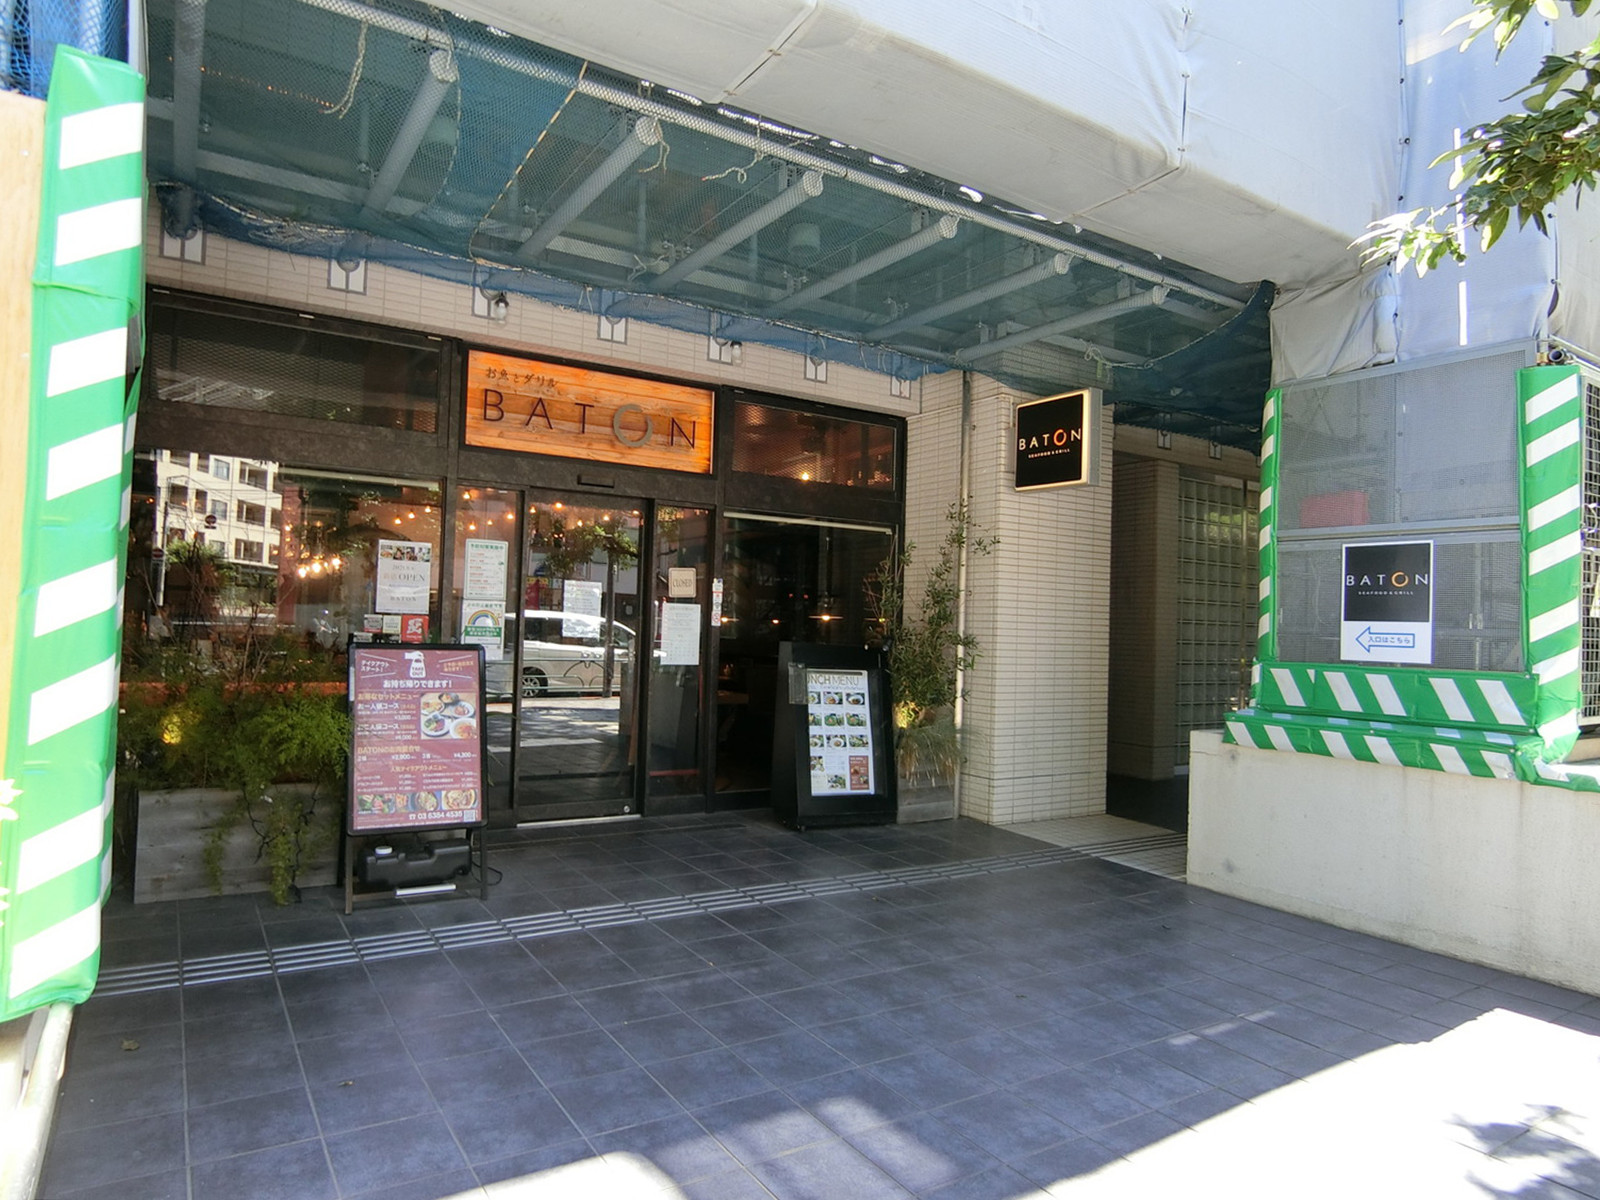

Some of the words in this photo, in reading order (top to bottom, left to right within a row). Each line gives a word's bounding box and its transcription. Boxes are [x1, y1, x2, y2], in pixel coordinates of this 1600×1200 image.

[483, 388, 696, 449] BATON
[1018, 428, 1081, 451] BATON
[672, 578, 693, 588] CLOSED
[1346, 571, 1428, 587] BATON
[1368, 636, 1411, 645] 入口はこちら
